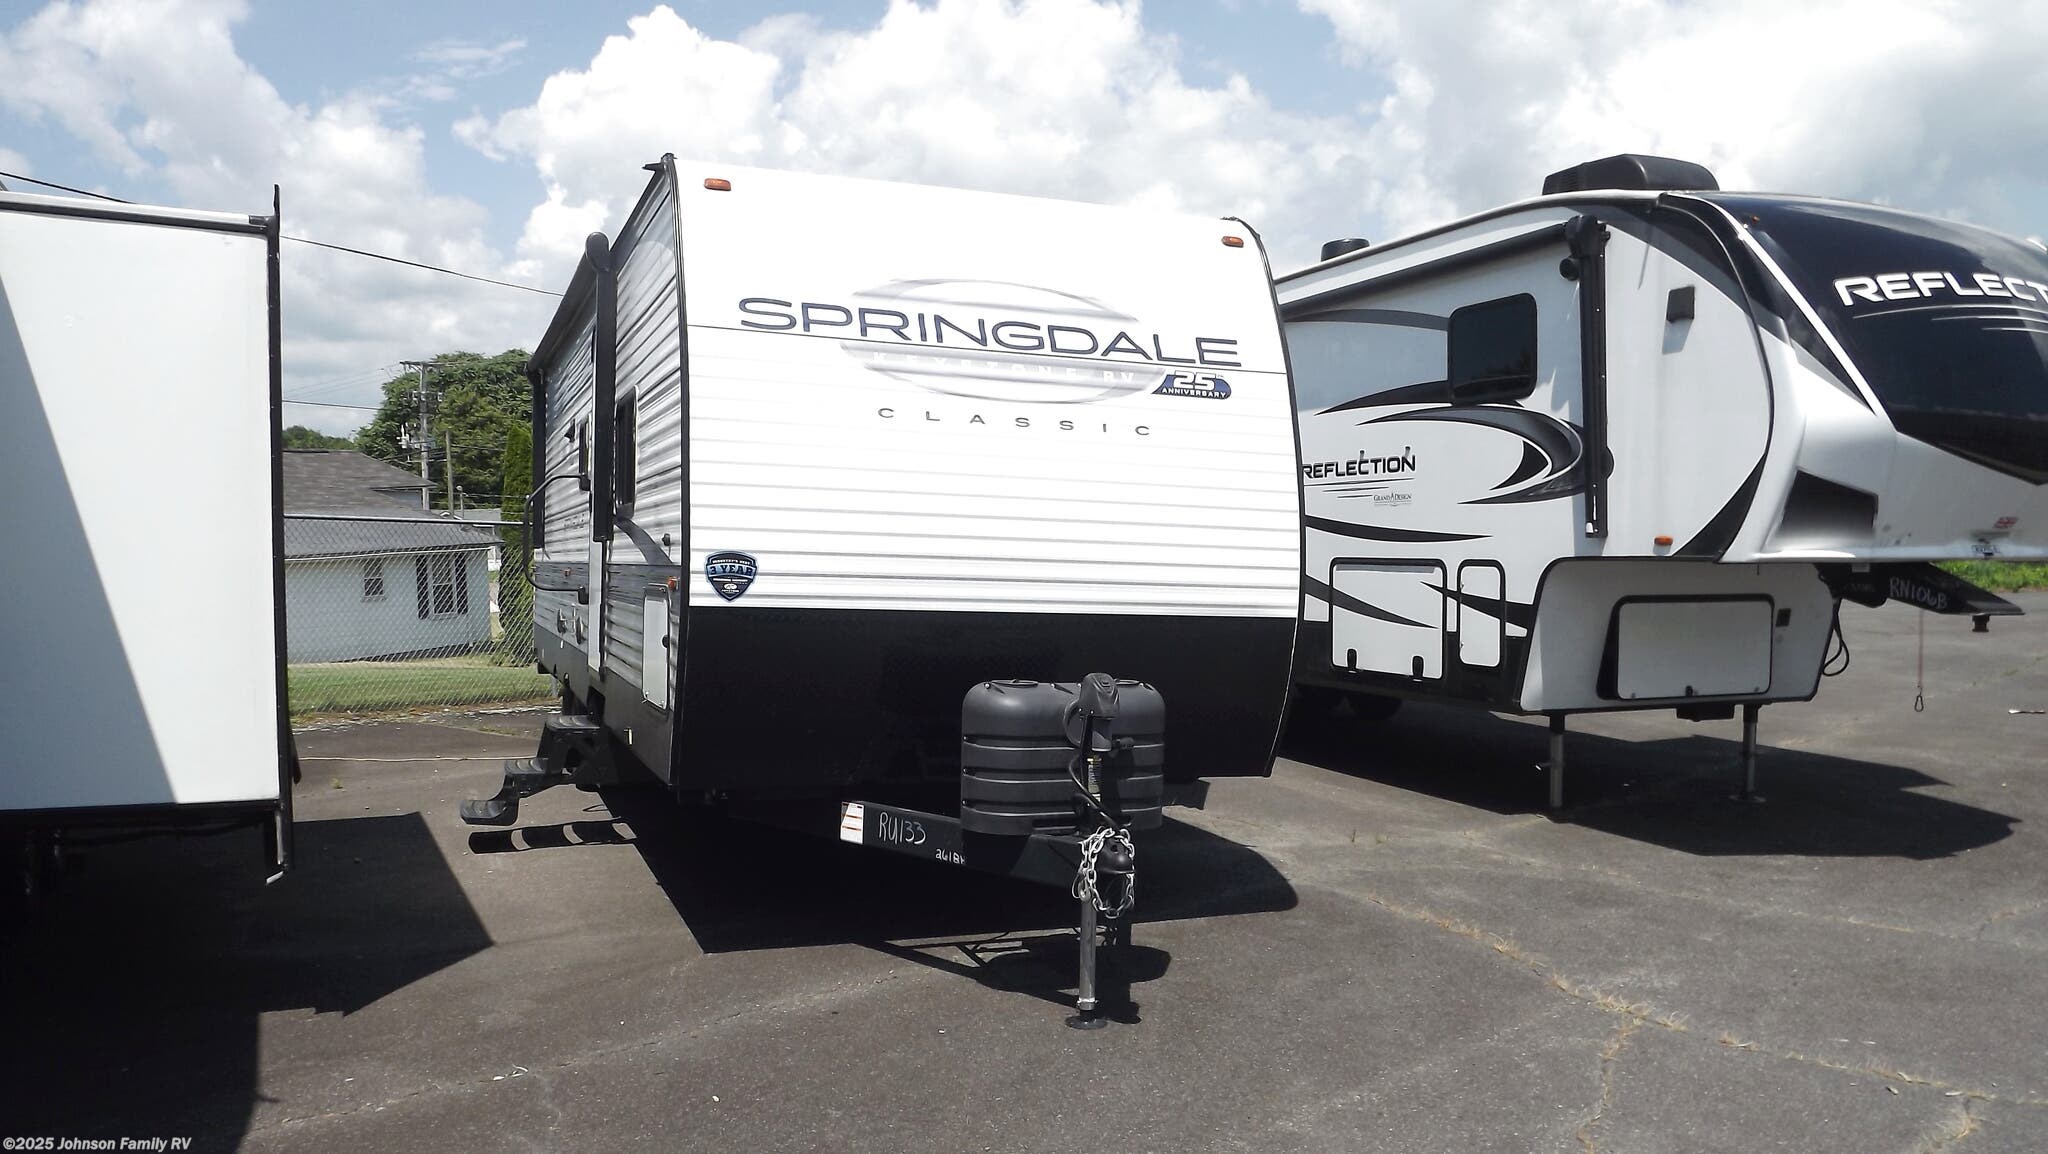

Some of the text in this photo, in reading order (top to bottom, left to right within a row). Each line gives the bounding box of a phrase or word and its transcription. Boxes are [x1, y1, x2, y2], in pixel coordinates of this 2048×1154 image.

[738, 296, 1242, 367] SPRINGDALE
[1103, 369, 1135, 383] RV
[1173, 370, 1216, 390] 25
[1161, 387, 1227, 398] ANNIVERSARY
[877, 407, 1151, 436] CLASSIC
[1301, 455, 1416, 479] REFLECTION
[709, 564, 753, 577] 3 YEAR
[1889, 577, 1949, 609] RN106B
